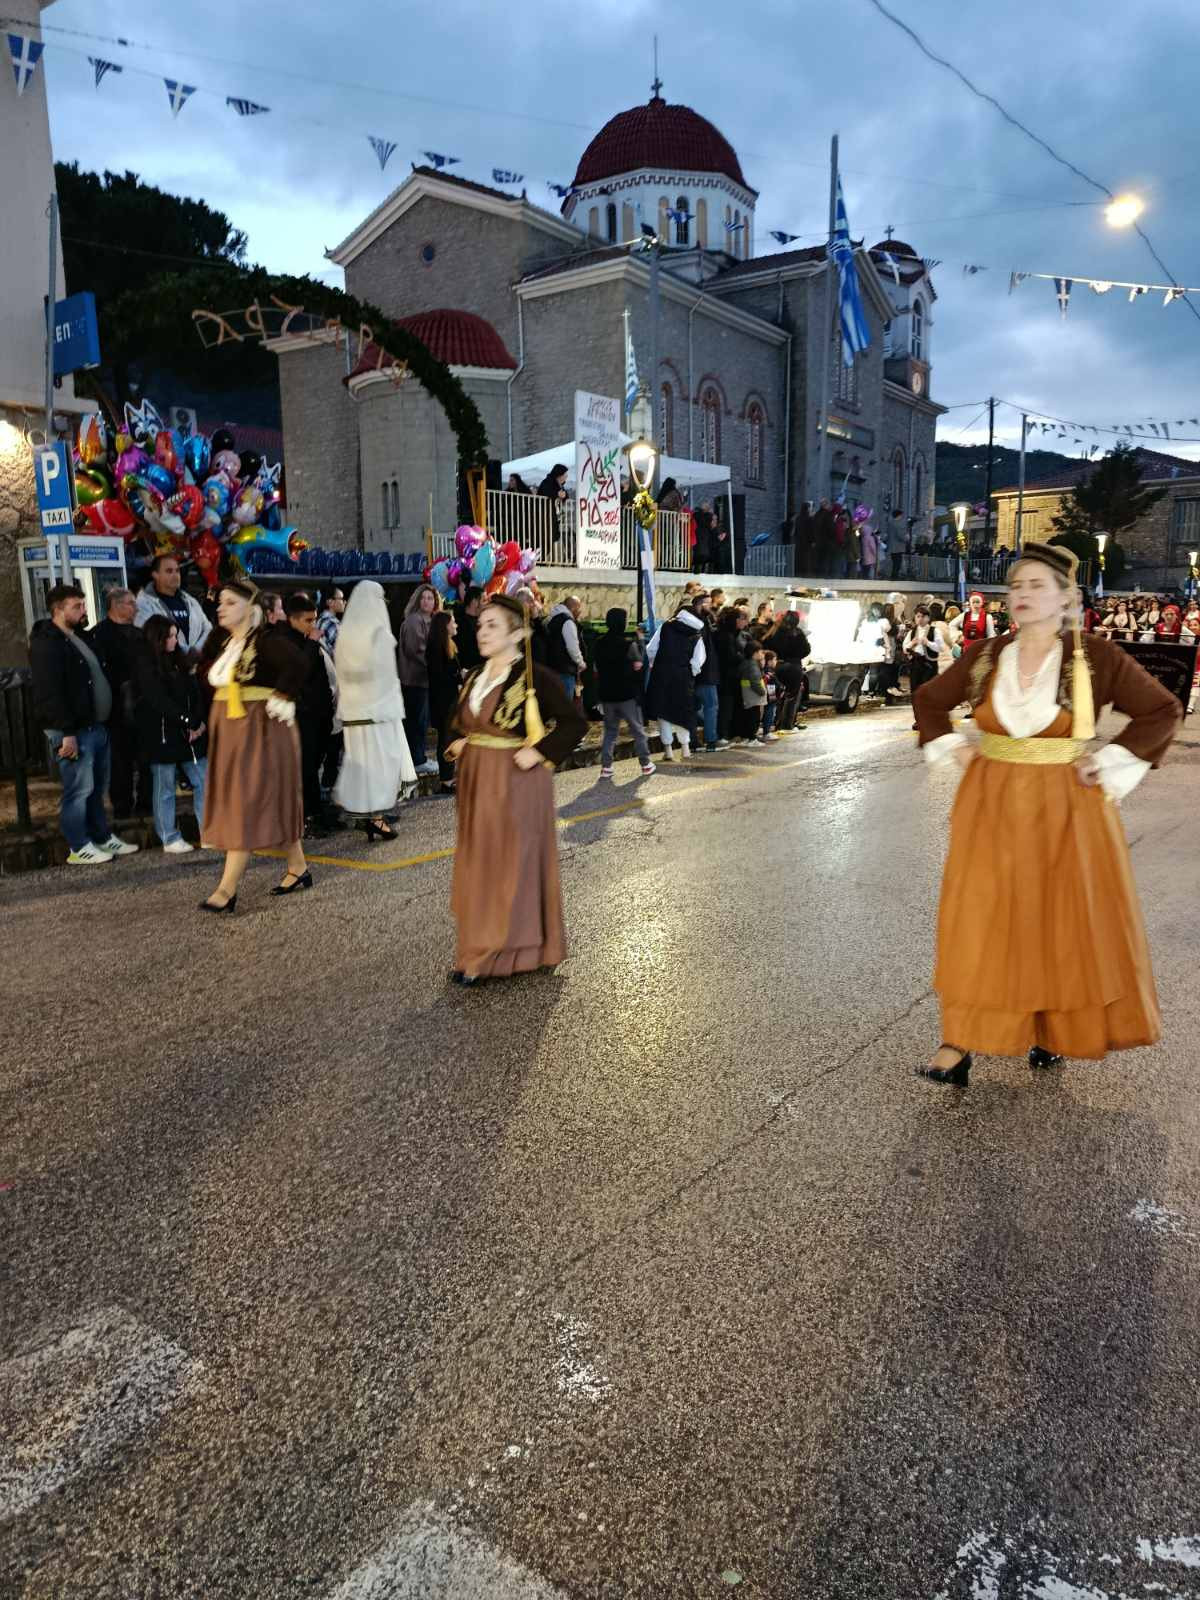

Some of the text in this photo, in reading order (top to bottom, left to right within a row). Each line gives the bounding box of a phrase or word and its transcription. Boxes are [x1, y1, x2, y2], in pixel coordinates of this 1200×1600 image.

[54, 322, 71, 343] ΕΠ
[41, 451, 60, 496] P
[47, 511, 67, 524] TAXI
